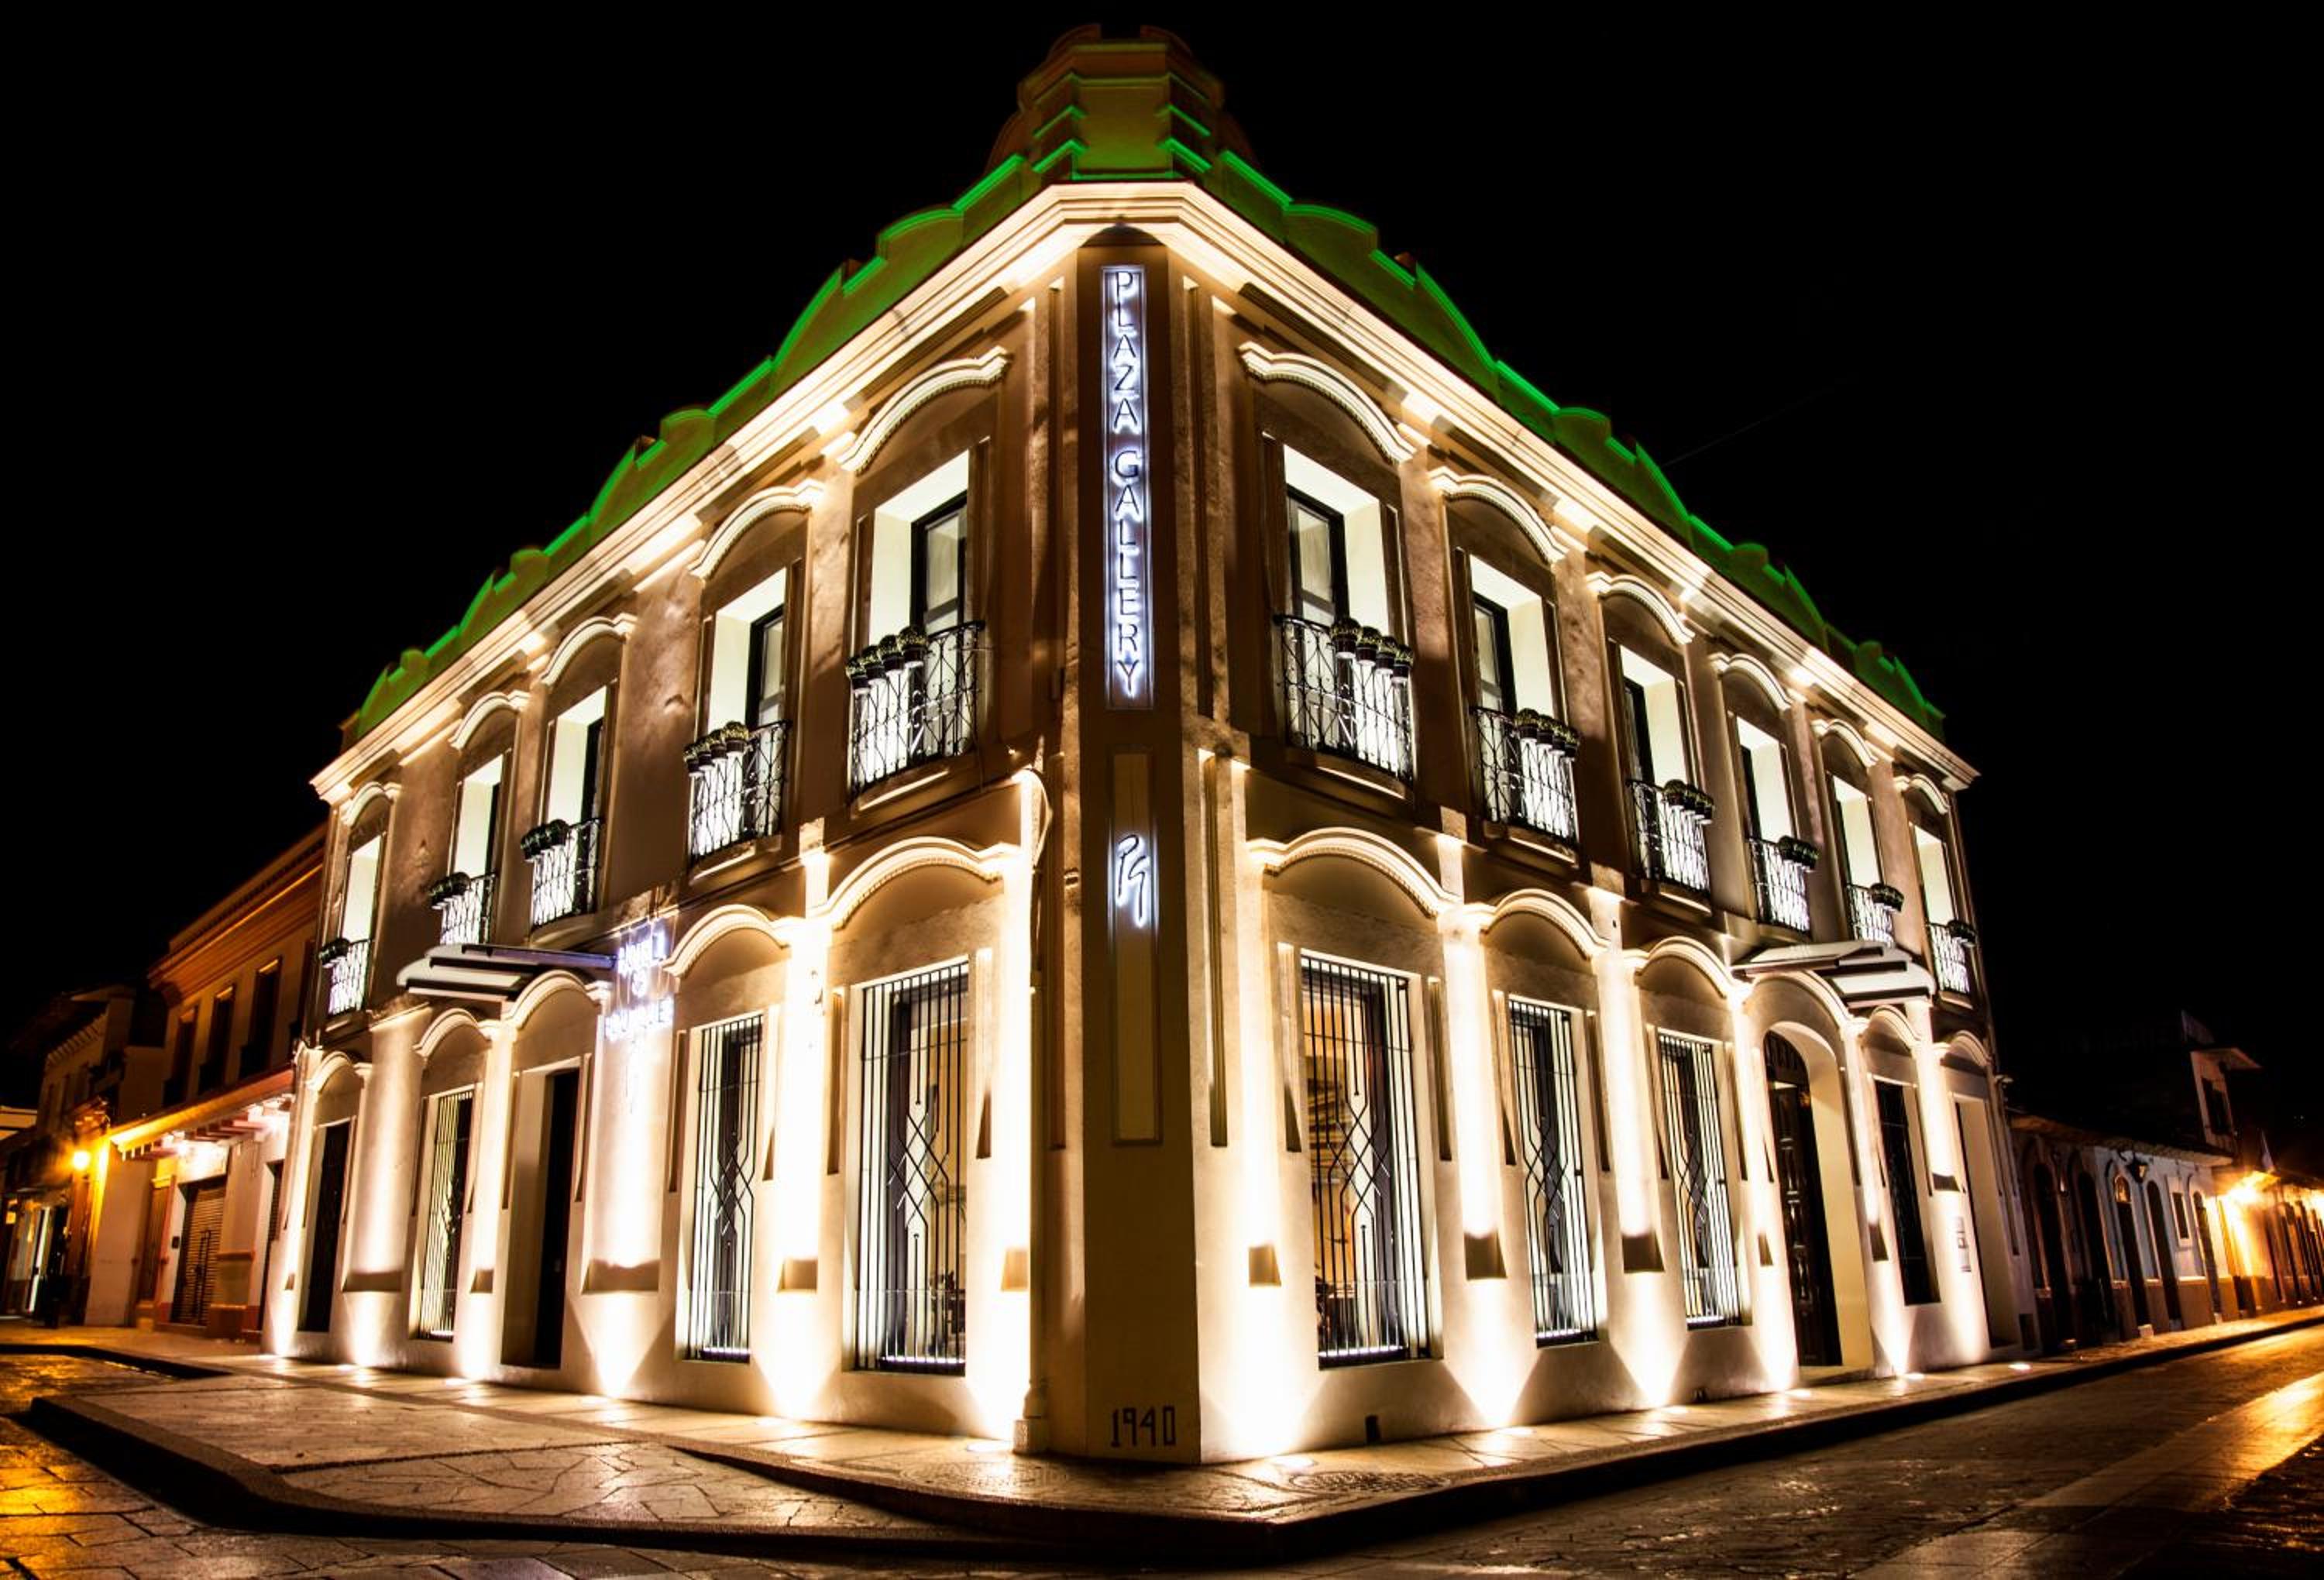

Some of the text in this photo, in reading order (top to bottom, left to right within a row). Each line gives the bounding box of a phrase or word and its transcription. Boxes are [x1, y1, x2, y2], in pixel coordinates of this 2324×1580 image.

[1113, 271, 1140, 695] PLAZA GALLERY
[1110, 1405, 1176, 1448] 1940
